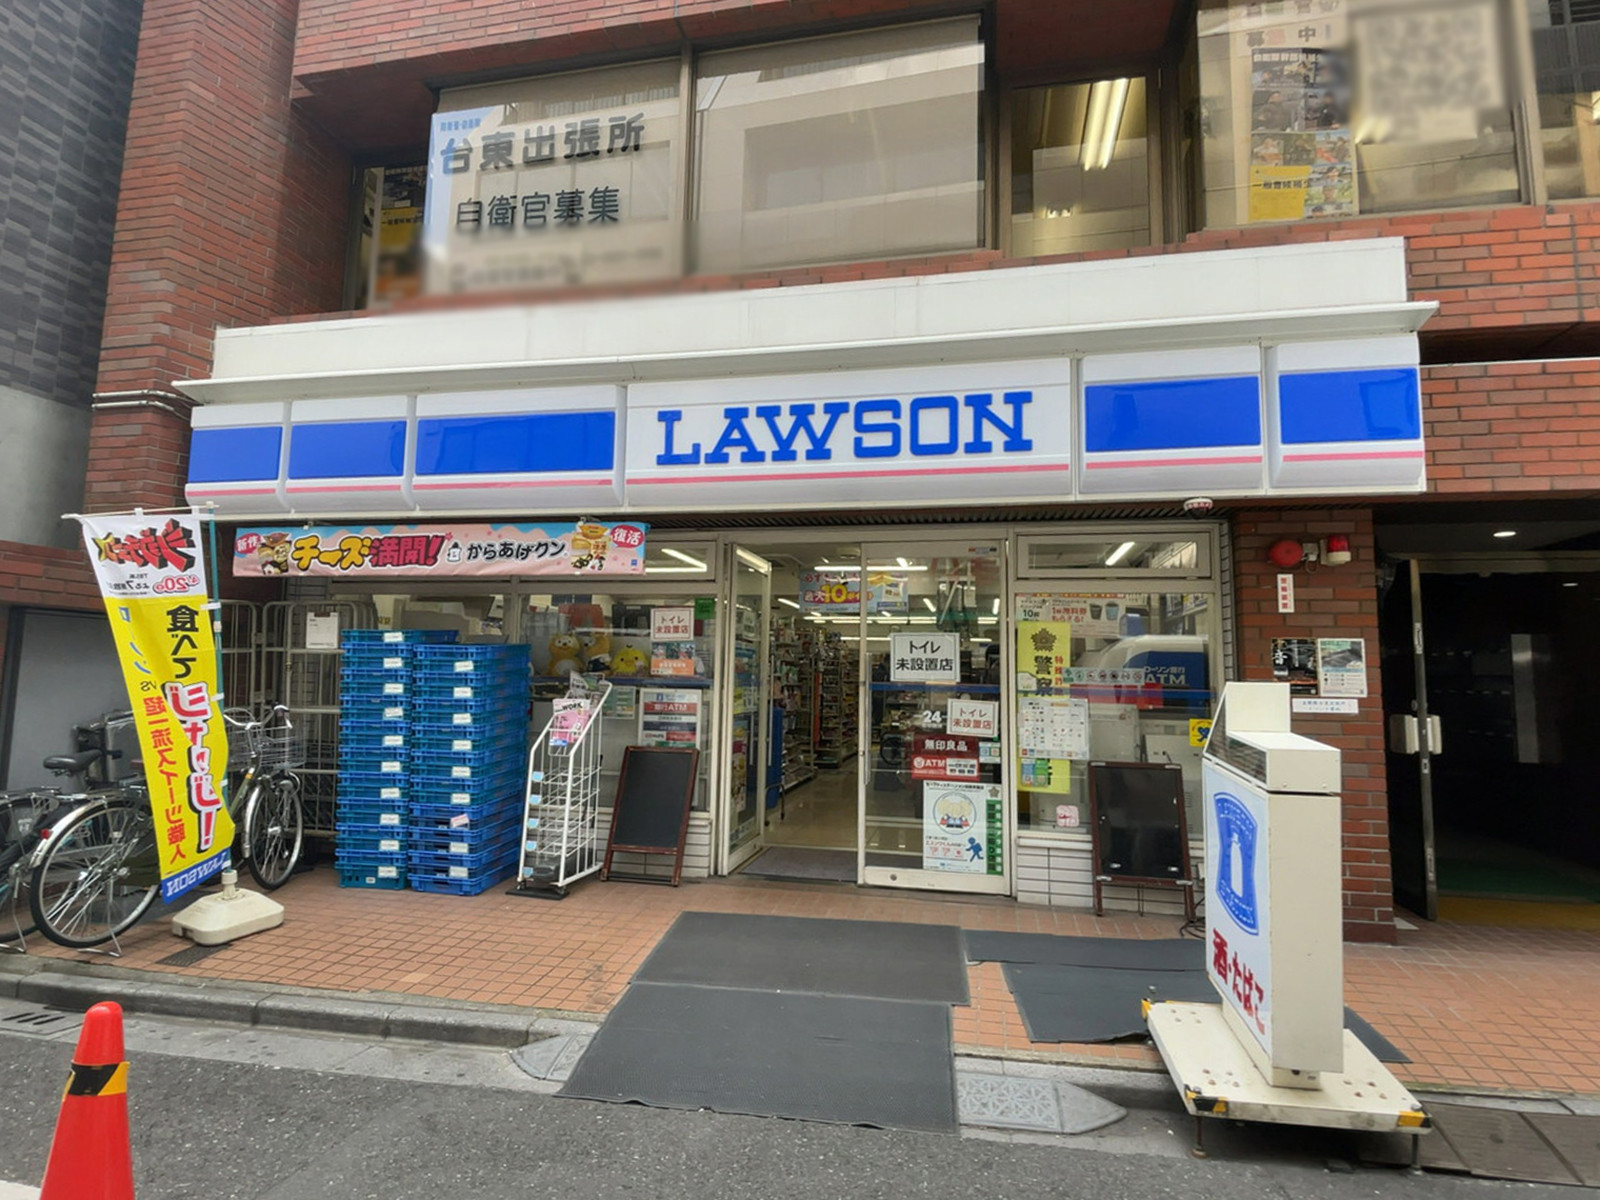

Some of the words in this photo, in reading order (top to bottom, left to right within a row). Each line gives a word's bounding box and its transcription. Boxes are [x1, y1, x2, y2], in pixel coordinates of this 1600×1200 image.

[440, 112, 646, 175] 台東出張所
[456, 186, 620, 227] 自衛官募集
[656, 390, 1033, 466] LAWSON
[613, 527, 640, 546] 復活
[292, 535, 442, 570] チーズ満開!
[467, 541, 566, 560] からあげクン
[661, 615, 684, 624] トイレ
[910, 640, 941, 654] トイレ
[896, 657, 954, 671] 未設置店
[1146, 674, 1186, 685] ATM
[922, 709, 942, 723] 24
[961, 708, 987, 718] トイレ
[953, 718, 993, 730] 未設置店
[924, 738, 968, 752] 無印良品
[925, 759, 946, 768] ATM
[1213, 928, 1265, 1035] 酒・たばこ
